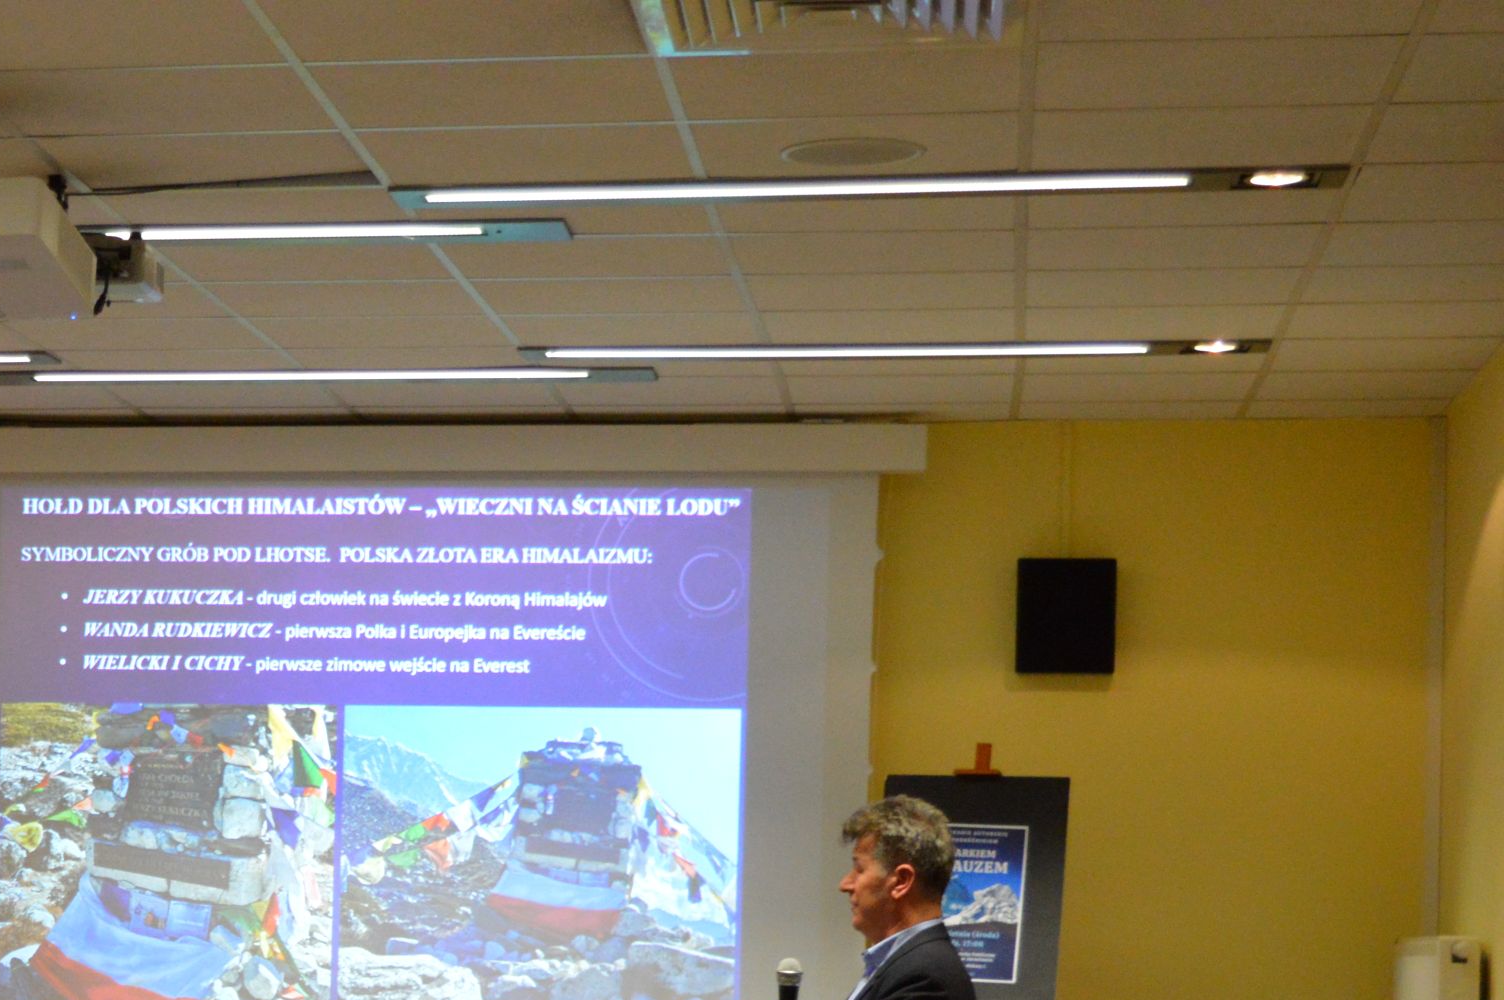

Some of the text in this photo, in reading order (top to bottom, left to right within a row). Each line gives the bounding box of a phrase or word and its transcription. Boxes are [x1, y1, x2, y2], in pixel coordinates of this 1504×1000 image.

[22, 497, 83, 515] HOŁD
[87, 497, 131, 515] DLA
[134, 497, 243, 516] POLSKICH
[247, 493, 406, 516] HIMALAISTÓW
[537, 498, 568, 515] NA
[572, 494, 661, 516] ŚCIANIE
[21, 543, 653, 565] SYMBOLICZNY GRÓB POD LHOTSE. POLSKA ZŁOTA ERA HIMALAIZMU:
[83, 589, 142, 605] JERZY
[143, 590, 244, 605] KUKUCZKA
[256, 590, 295, 608] drugi
[300, 590, 365, 606] człowiek
[369, 594, 389, 606] na
[392, 590, 451, 607] świecie
[453, 595, 462, 607] z
[465, 592, 521, 610] Koroną
[524, 591, 608, 611] Himalajów
[84, 622, 148, 638] WANDA
[152, 622, 274, 638] RUDKIEWICZ
[285, 625, 352, 641] pierwsza
[356, 624, 397, 640] Polka
[400, 625, 406, 640] i
[409, 625, 486, 643] Europejka
[490, 628, 510, 641] na
[513, 625, 586, 641] Evereście
[83, 655, 169, 671] WIELICKI
[171, 655, 181, 671] I
[184, 655, 245, 671] CICHY
[256, 657, 323, 674] pierwsze
[326, 657, 385, 673] zimowe
[390, 658, 446, 676] wejście
[450, 661, 470, 674] na
[473, 659, 530, 674] Everest
[955, 848, 997, 859] ARKIEM
[952, 860, 1008, 875] AUZEM
